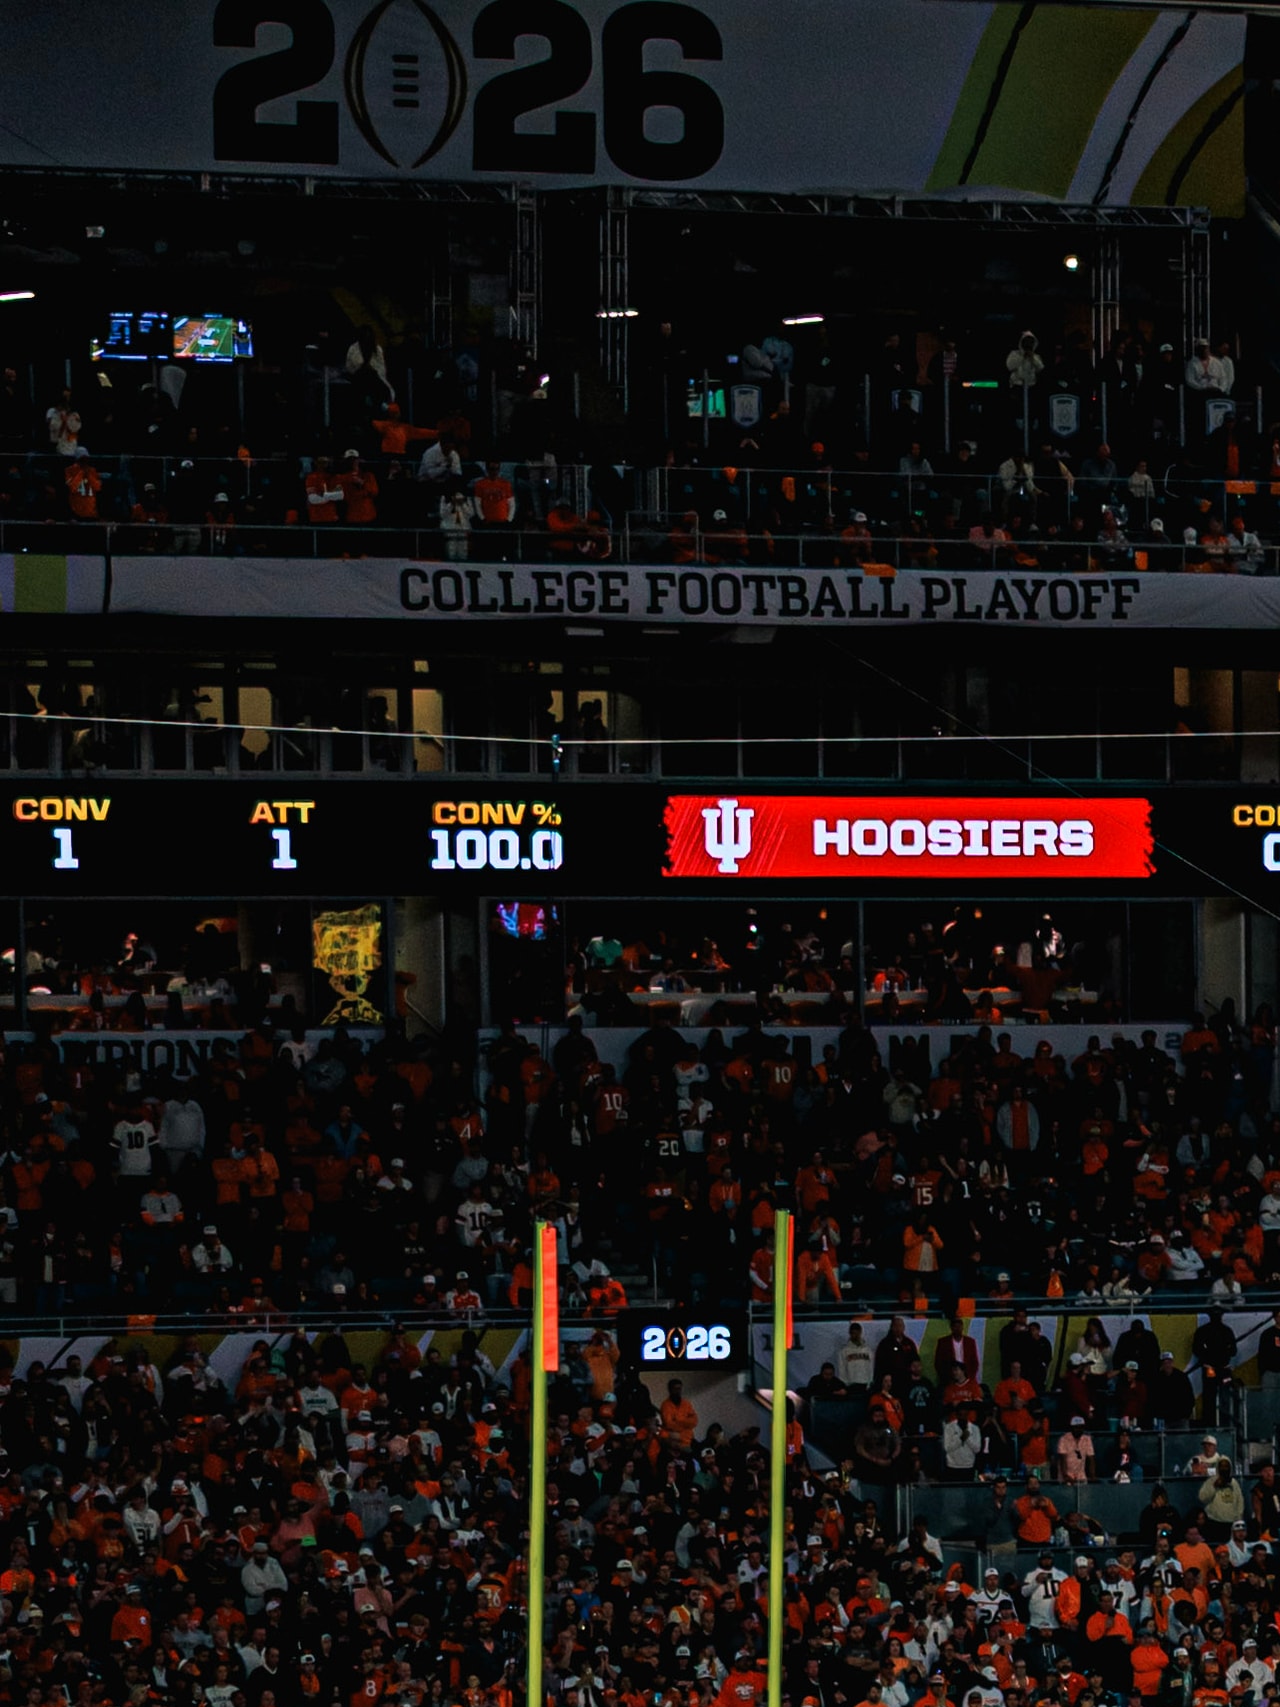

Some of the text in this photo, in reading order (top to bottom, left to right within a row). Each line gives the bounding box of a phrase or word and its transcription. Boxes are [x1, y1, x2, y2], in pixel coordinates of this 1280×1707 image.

[400, 568, 1140, 620] COLLEGE FOOTBALL PLAYOFF
[14, 797, 111, 824] CONV
[249, 800, 315, 825] ATT
[432, 802, 562, 826] CONV %
[53, 828, 79, 869] 1
[271, 829, 297, 869] 1
[812, 818, 1095, 857] HOOSIERS
[430, 829, 563, 871] 100.0
[775, 1066, 793, 1084] 10
[604, 1093, 624, 1112] 10
[128, 1131, 145, 1149] 10
[659, 1140, 680, 1157] 20
[917, 1187, 933, 1206] 15
[366, 1680, 378, 1698] 8
